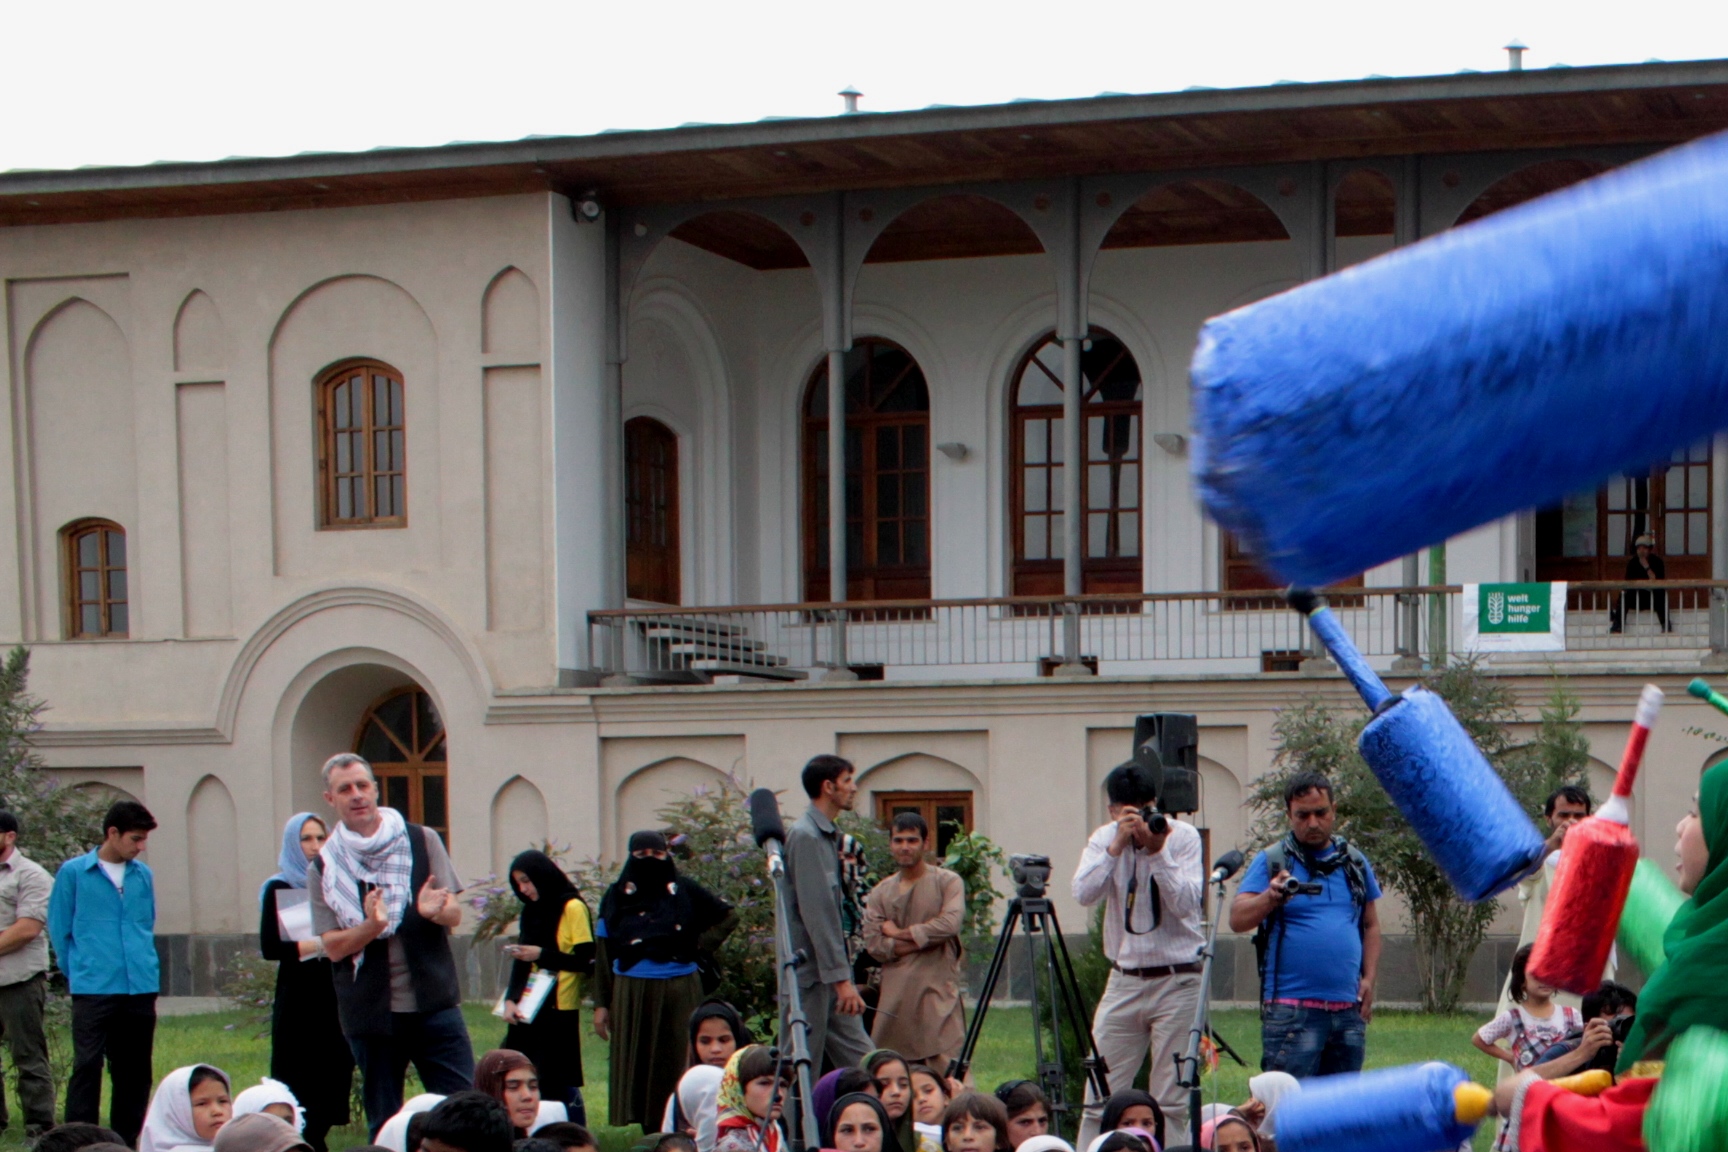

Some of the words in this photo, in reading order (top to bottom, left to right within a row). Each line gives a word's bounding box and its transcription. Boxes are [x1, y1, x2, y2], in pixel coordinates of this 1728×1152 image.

[1507, 593, 1529, 603] welt
[1507, 604, 1541, 615] hunger
[1507, 613, 1529, 624] hilfe
